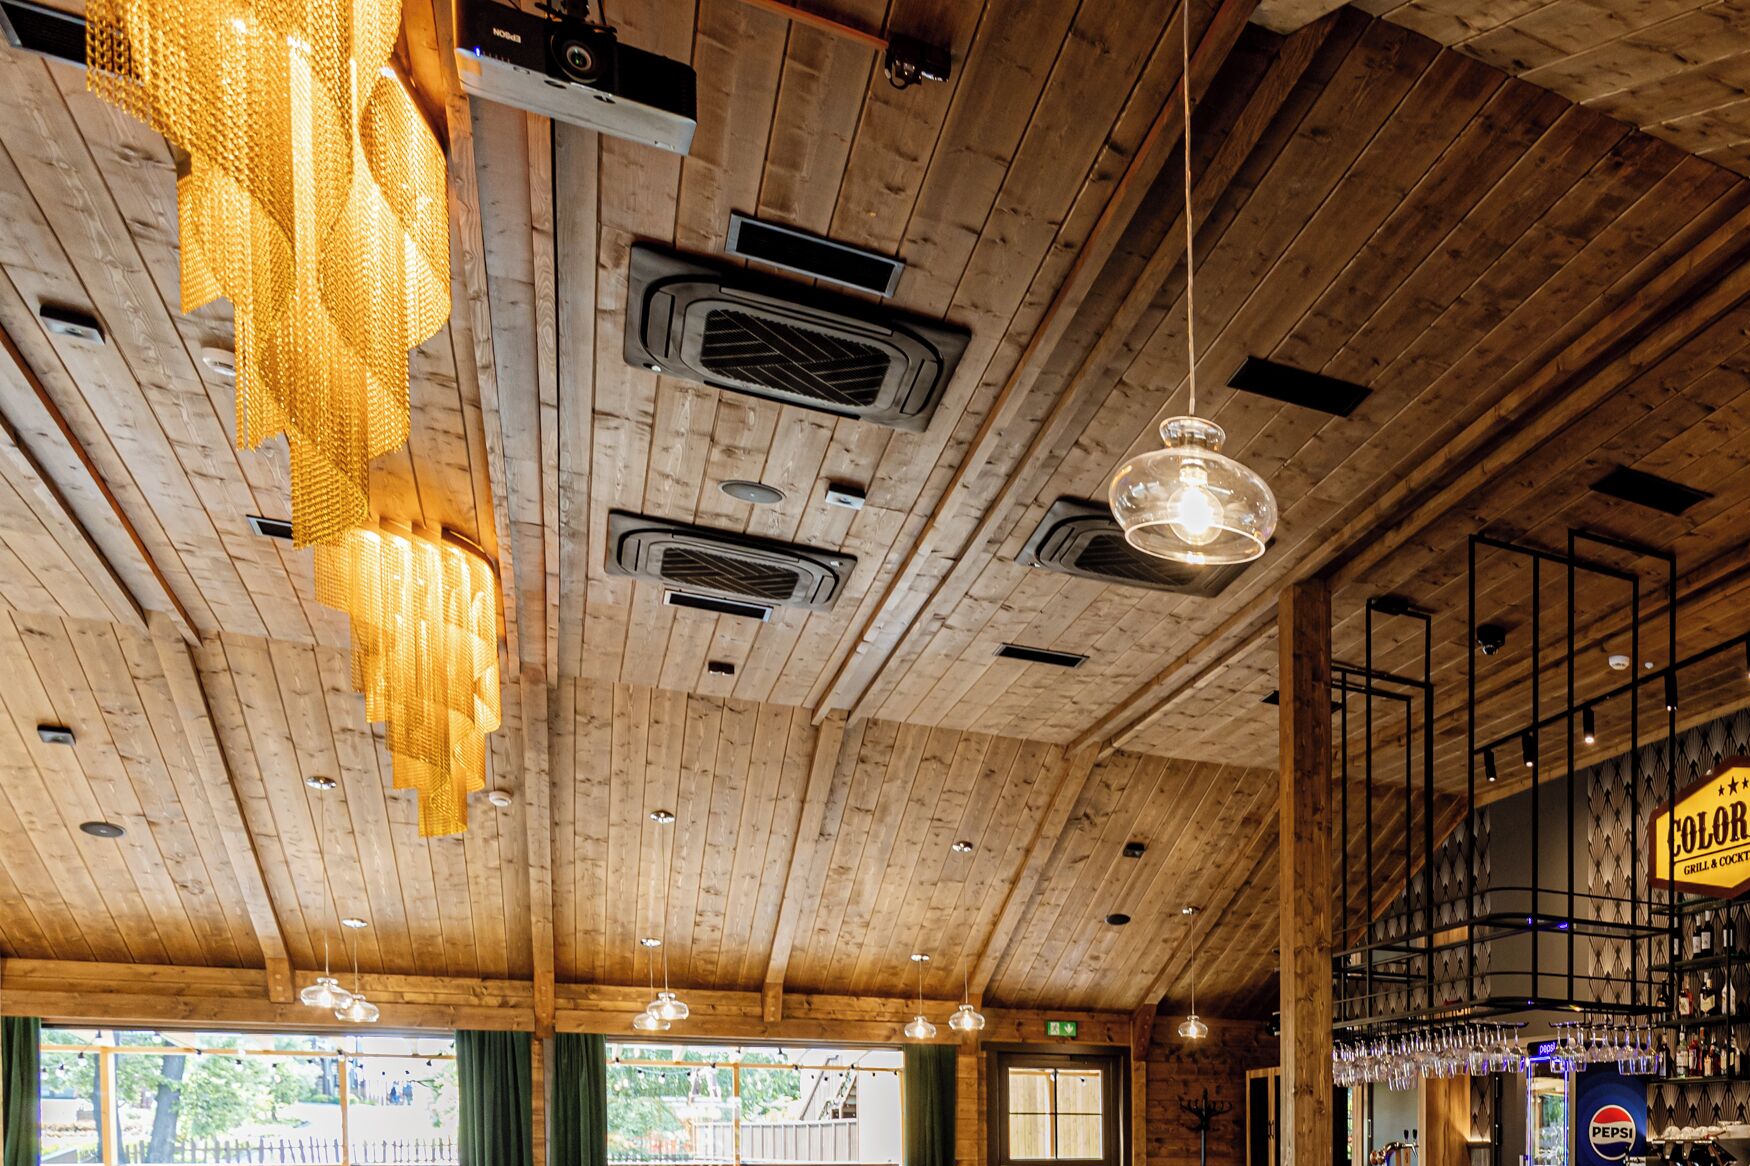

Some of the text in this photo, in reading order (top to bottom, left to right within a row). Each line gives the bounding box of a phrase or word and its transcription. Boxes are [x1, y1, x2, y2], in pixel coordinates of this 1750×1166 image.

[492, 27, 522, 44] EPSON
[1684, 860, 1709, 875] GRILL
[1711, 859, 1718, 868] &
[1592, 1126, 1633, 1139] PEPSI
